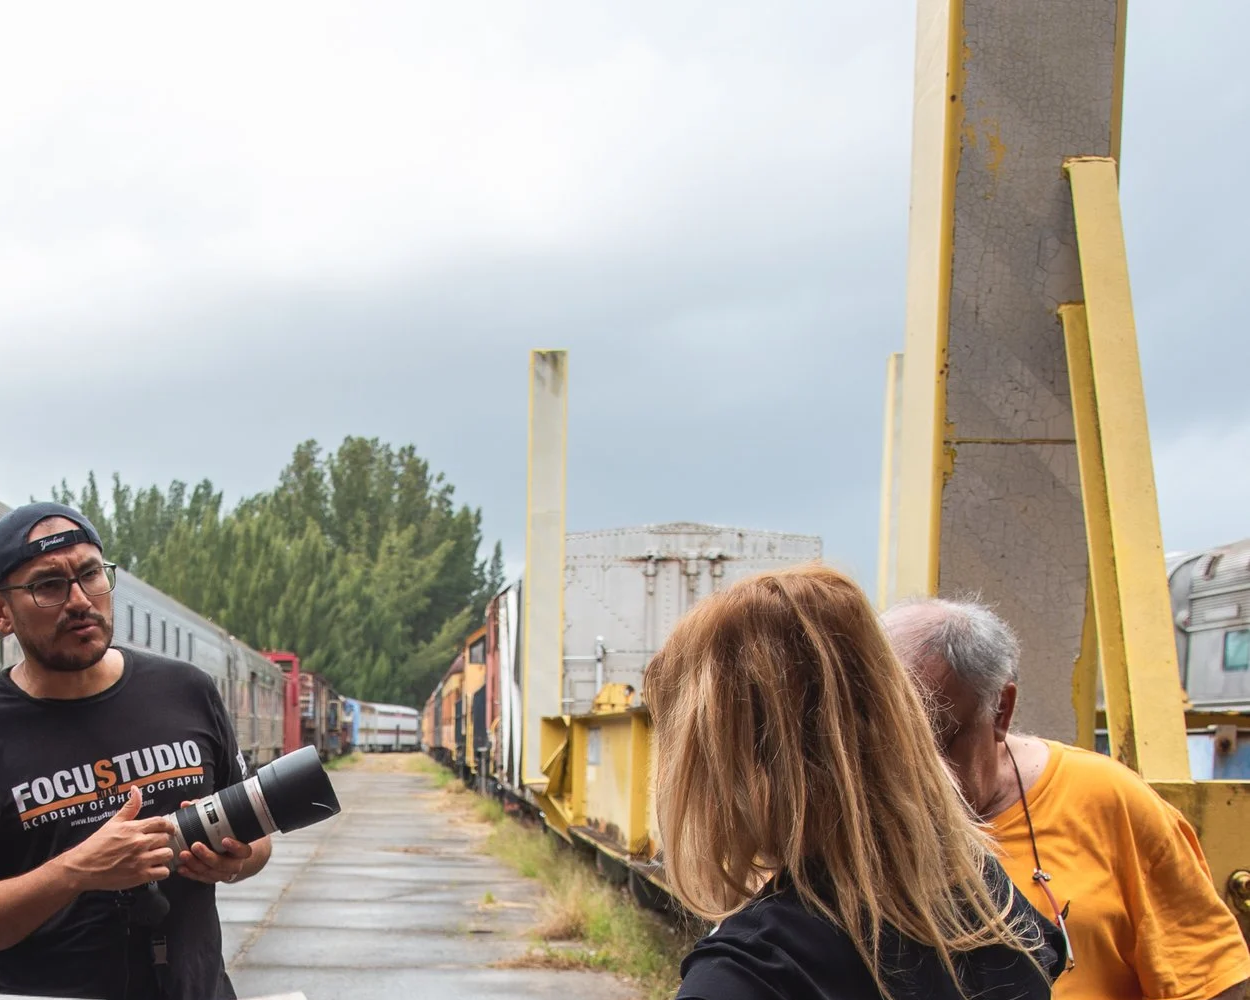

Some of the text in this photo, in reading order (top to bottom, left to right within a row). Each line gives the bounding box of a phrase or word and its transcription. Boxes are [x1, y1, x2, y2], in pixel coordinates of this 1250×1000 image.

[11, 740, 202, 814] FOCUSTUDIO
[23, 803, 85, 831] ACADEMY
[89, 799, 105, 812] OF
